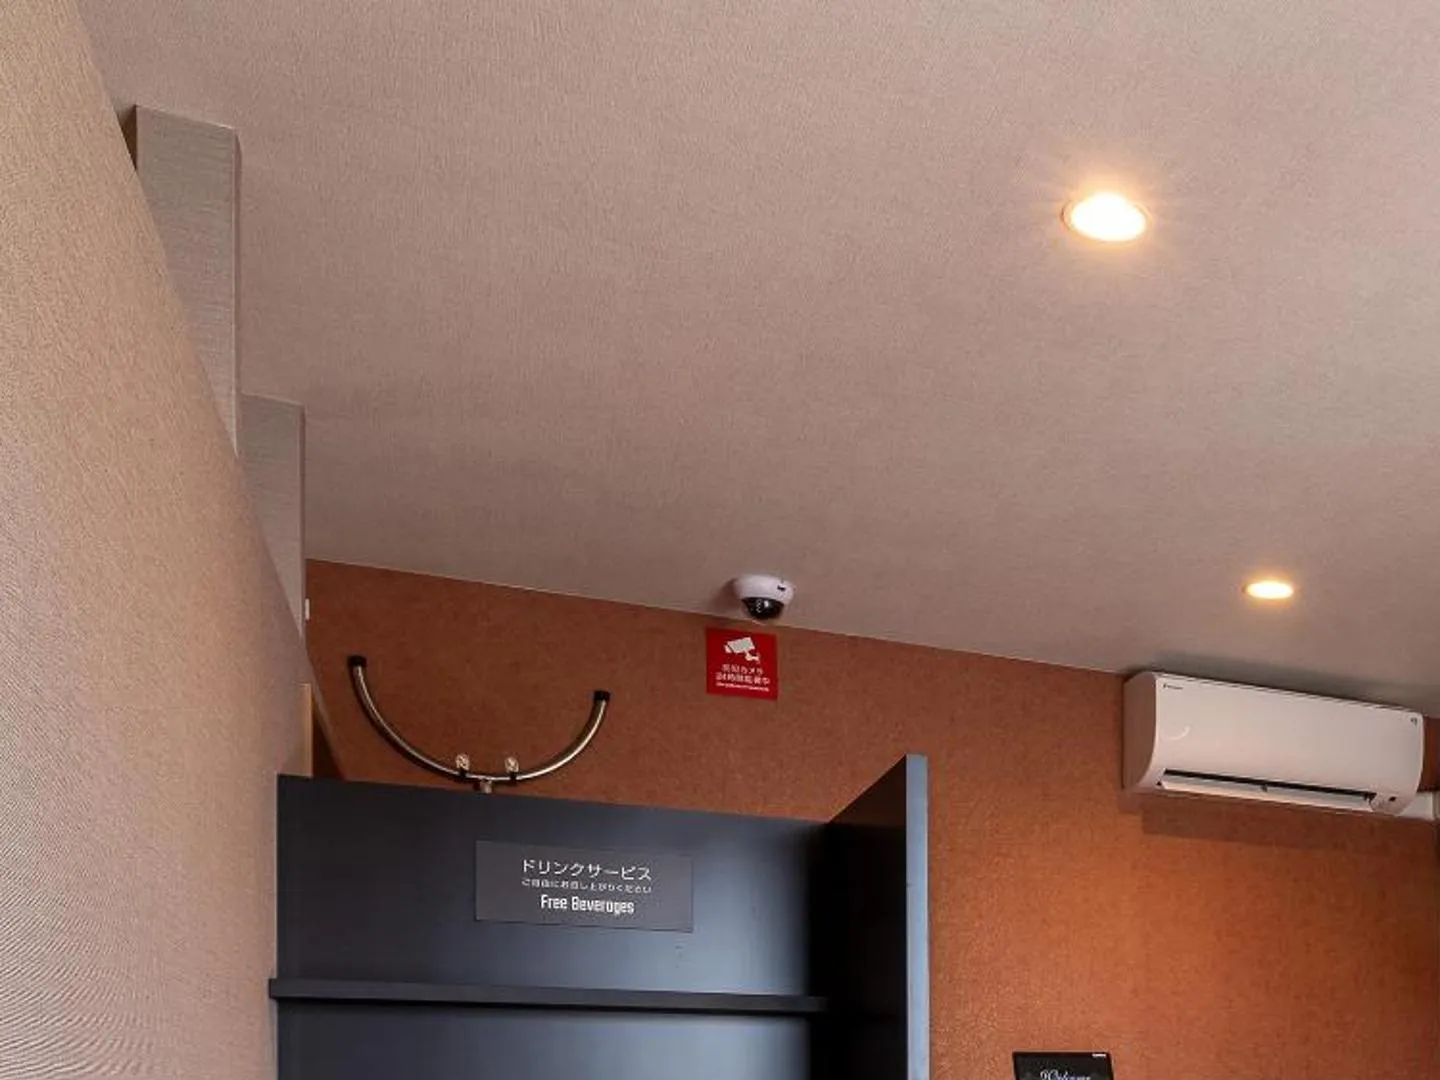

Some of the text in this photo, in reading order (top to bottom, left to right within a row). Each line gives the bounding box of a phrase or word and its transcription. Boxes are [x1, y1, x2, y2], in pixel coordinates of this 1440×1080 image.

[523, 859, 652, 881] ドリンクサービス
[540, 894, 635, 915] Free Beverages
